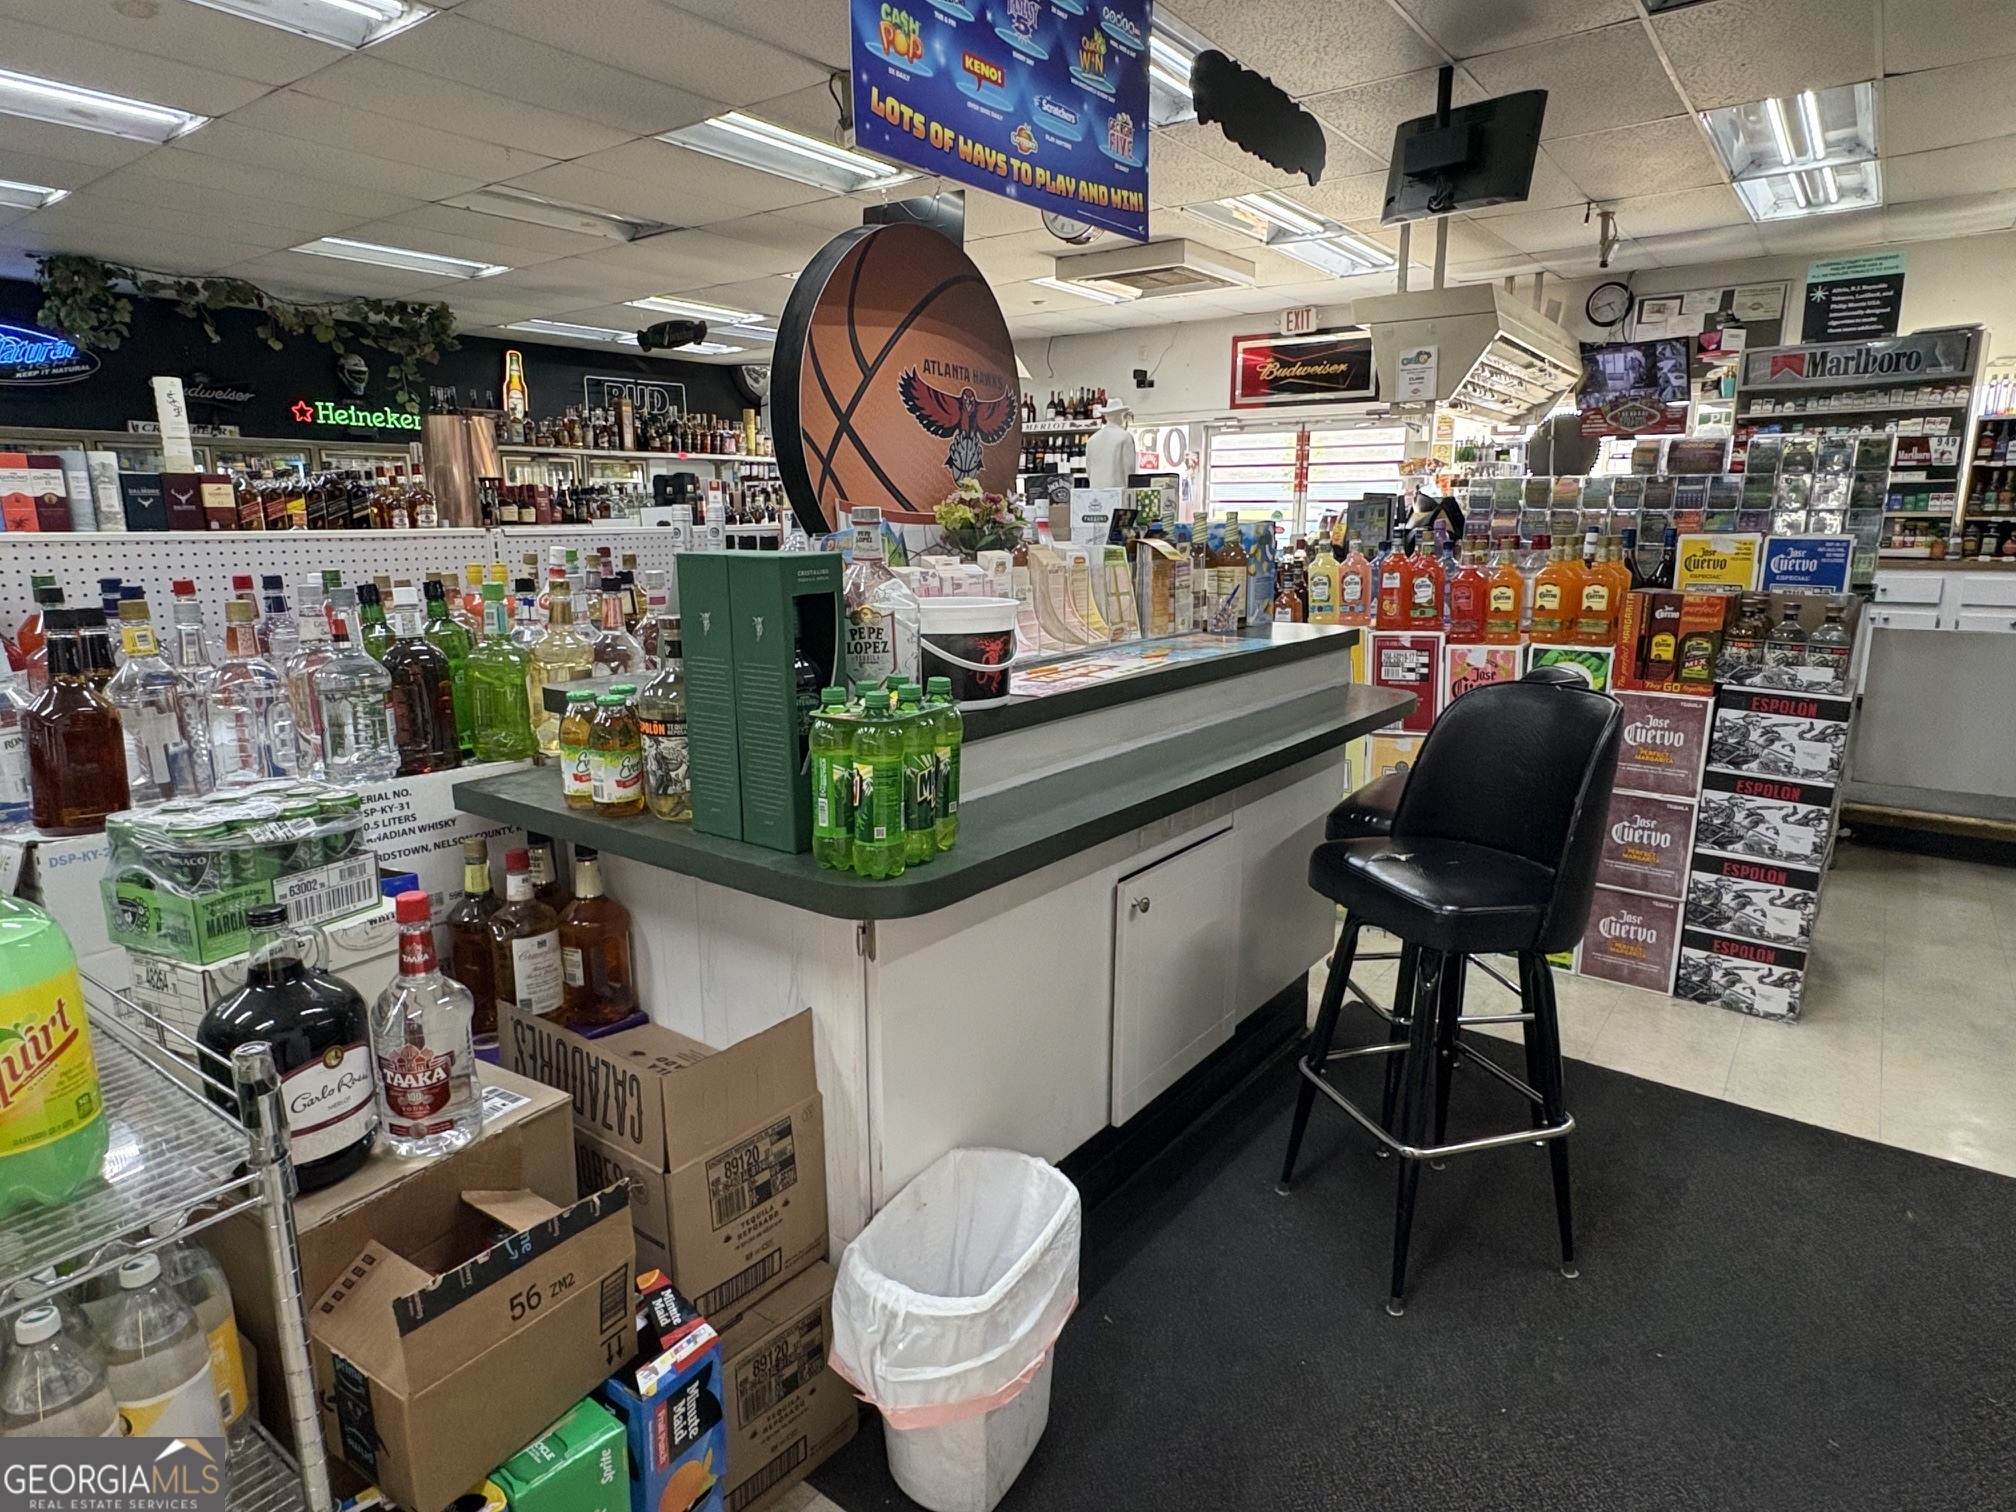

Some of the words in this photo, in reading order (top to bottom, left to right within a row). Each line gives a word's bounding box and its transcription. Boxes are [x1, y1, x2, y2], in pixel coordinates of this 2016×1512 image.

[881, 3, 920, 36] CASH
[879, 21, 924, 64] POP
[895, 70, 911, 82] DAILY
[965, 55, 1003, 83] KENO!
[870, 86, 925, 140] LOTS
[930, 120, 955, 154] OF
[957, 135, 1008, 178] WAYS
[1009, 157, 1033, 187] TO
[1035, 167, 1077, 199] PLAY
[1078, 181, 1109, 208] AND
[1110, 190, 1144, 213] WIN!
[1109, 132, 1134, 160] FIVE
[1286, 308, 1312, 332] EXIT
[15, 369, 40, 379] KEEP
[41, 368, 50, 377] IT
[51, 364, 91, 375] NATURAL
[923, 358, 971, 383] ATLANTA
[1257, 360, 1349, 381] Budweiser
[1805, 347, 1922, 379] Marlboro
[1025, 422, 1067, 431] MERLOT
[1897, 446, 1931, 460] Marlboro
[1684, 553, 1727, 573] Cuervo
[1700, 547, 1717, 558] Jose
[1788, 547, 1807, 559] Jose
[1770, 554, 1818, 574] Cuervo
[1622, 593, 1635, 643] MARGARITA
[1655, 609, 1680, 619] Cuervo
[849, 626, 884, 641] PEPE
[847, 640, 889, 655] LOPEZ
[1472, 667, 1497, 681] Jose
[1685, 658, 1706, 668] MIX
[1645, 681, 1663, 690] They
[1663, 682, 1680, 692] GO
[1682, 684, 1712, 693] together
[1646, 715, 1670, 728] Jose
[1624, 722, 1684, 747] Cuervo
[360, 791, 391, 804] ERIAL
[393, 788, 412, 798] NO.
[363, 801, 411, 818] SP-KY-31
[363, 822, 380, 832] 0.5
[382, 813, 417, 828] LITERS
[418, 818, 457, 832] WHISKY
[1632, 815, 1657, 829] Jose
[1612, 821, 1671, 848] Cuervo
[377, 845, 432, 863] RDSTOWN,
[288, 879, 318, 898] 63002
[206, 910, 249, 939] MARGA
[368, 911, 396, 926] WHIT
[1619, 910, 1643, 924] Jose
[1599, 916, 1657, 943] Cuervo
[402, 952, 430, 964] TAAKA
[0, 997, 72, 1110] uirt
[383, 1066, 448, 1088] TAAKA
[513, 1018, 643, 1144] CAZADORES
[290, 1085, 335, 1114] Carlo
[327, 1096, 351, 1110] MERLOT
[407, 1092, 421, 1101] 100
[724, 1145, 760, 1180] 89120
[737, 1210, 780, 1241] REPOSADO
[741, 1204, 775, 1228] TEQUILA
[509, 1283, 543, 1321] 56
[550, 1272, 576, 1298] ZM2
[661, 1289, 682, 1326] Minute
[652, 1298, 671, 1327] Maid
[752, 1340, 789, 1377] 89120
[686, 1380, 700, 1440] Minute
[763, 1401, 806, 1434] REPOSADO
[766, 1395, 801, 1421] TEQUILA
[657, 1409, 667, 1432] Fruit
[673, 1398, 689, 1445] Maid
[533, 1442, 556, 1462] CYCLE
[658, 1432, 669, 1465] Punch
[600, 1448, 616, 1484] Sprite
